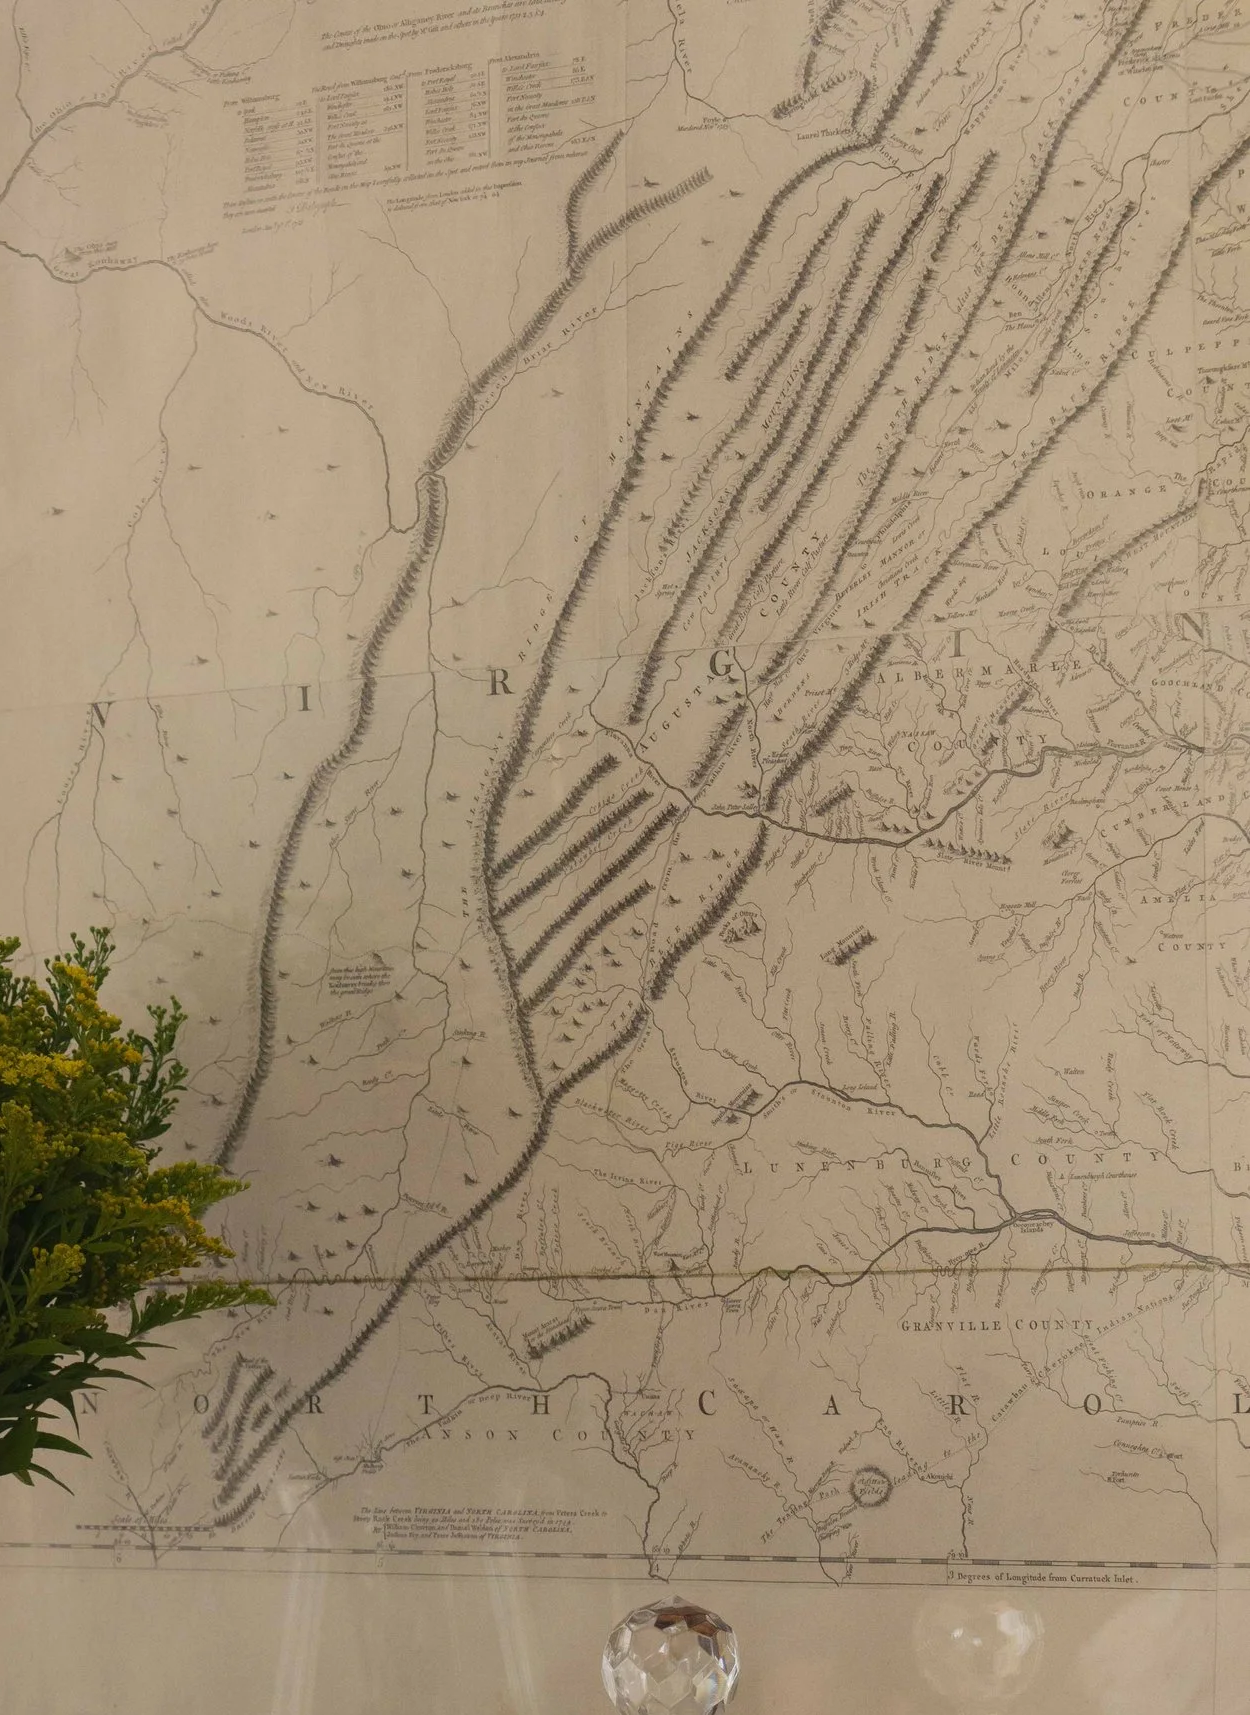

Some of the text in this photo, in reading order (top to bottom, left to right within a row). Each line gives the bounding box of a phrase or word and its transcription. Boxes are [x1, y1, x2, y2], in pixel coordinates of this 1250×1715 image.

[1086, 485, 1167, 500] ORANGE
[1157, 941, 1228, 953] COUNTY
[743, 1156, 972, 1176] LUNENBURG
[1010, 1151, 1161, 1167] COUNTY
[901, 1318, 1094, 1332] GRANVILLE COUNTY
[422, 1428, 520, 1442] ANSON
[956, 1571, 991, 1584] Degrees
[994, 1571, 1005, 1583] of
[1005, 1572, 1048, 1585] Longitude
[1048, 1572, 1069, 1584] from
[1069, 1573, 1111, 1584] Curratuck
